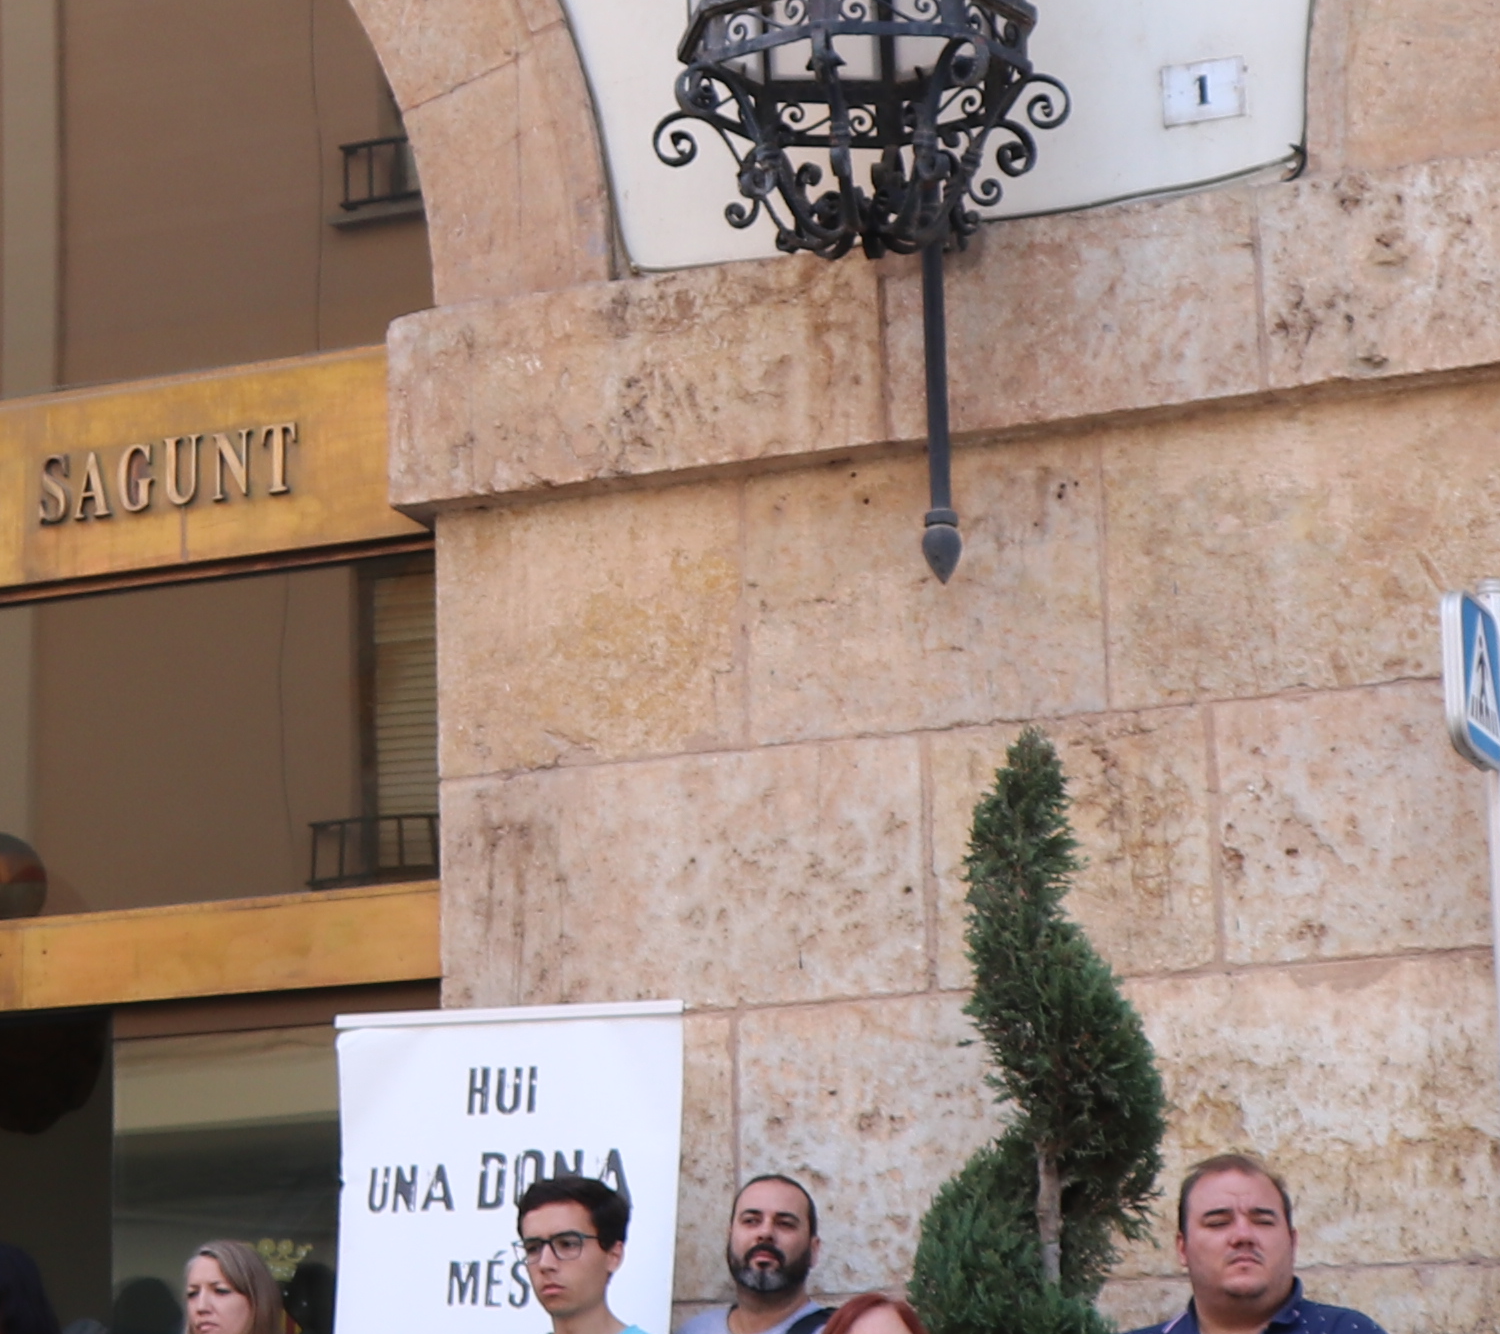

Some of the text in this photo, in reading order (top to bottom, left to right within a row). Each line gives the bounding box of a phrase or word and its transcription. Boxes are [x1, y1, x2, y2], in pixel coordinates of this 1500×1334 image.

[1194, 73, 1210, 107] 1
[38, 421, 298, 526] SAGUNT
[467, 1065, 538, 1115] HUI
[368, 1164, 455, 1213] UNA
[447, 1249, 531, 1309] MÉS
